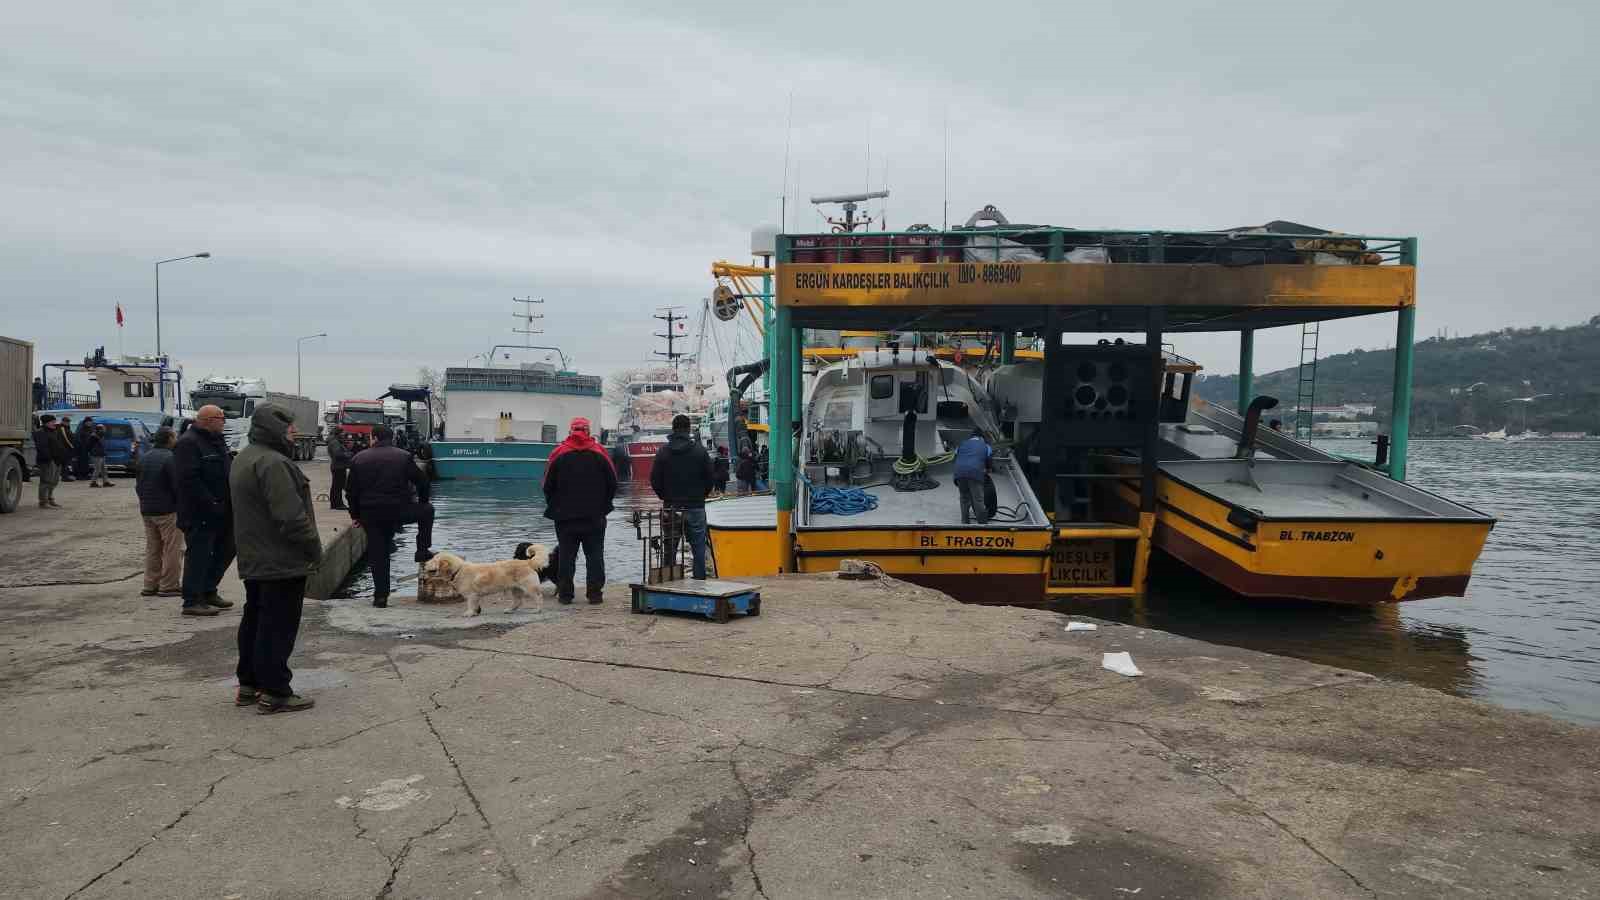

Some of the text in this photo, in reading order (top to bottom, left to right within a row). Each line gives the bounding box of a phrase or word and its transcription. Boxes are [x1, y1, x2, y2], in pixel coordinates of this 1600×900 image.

[958, 263, 976, 283] IMO
[795, 270, 950, 295] ERGÜN KARDEŞLER BALIKÇILIK
[920, 535, 1015, 548] BL TRABZON
[1300, 531, 1355, 542] TRABZON
